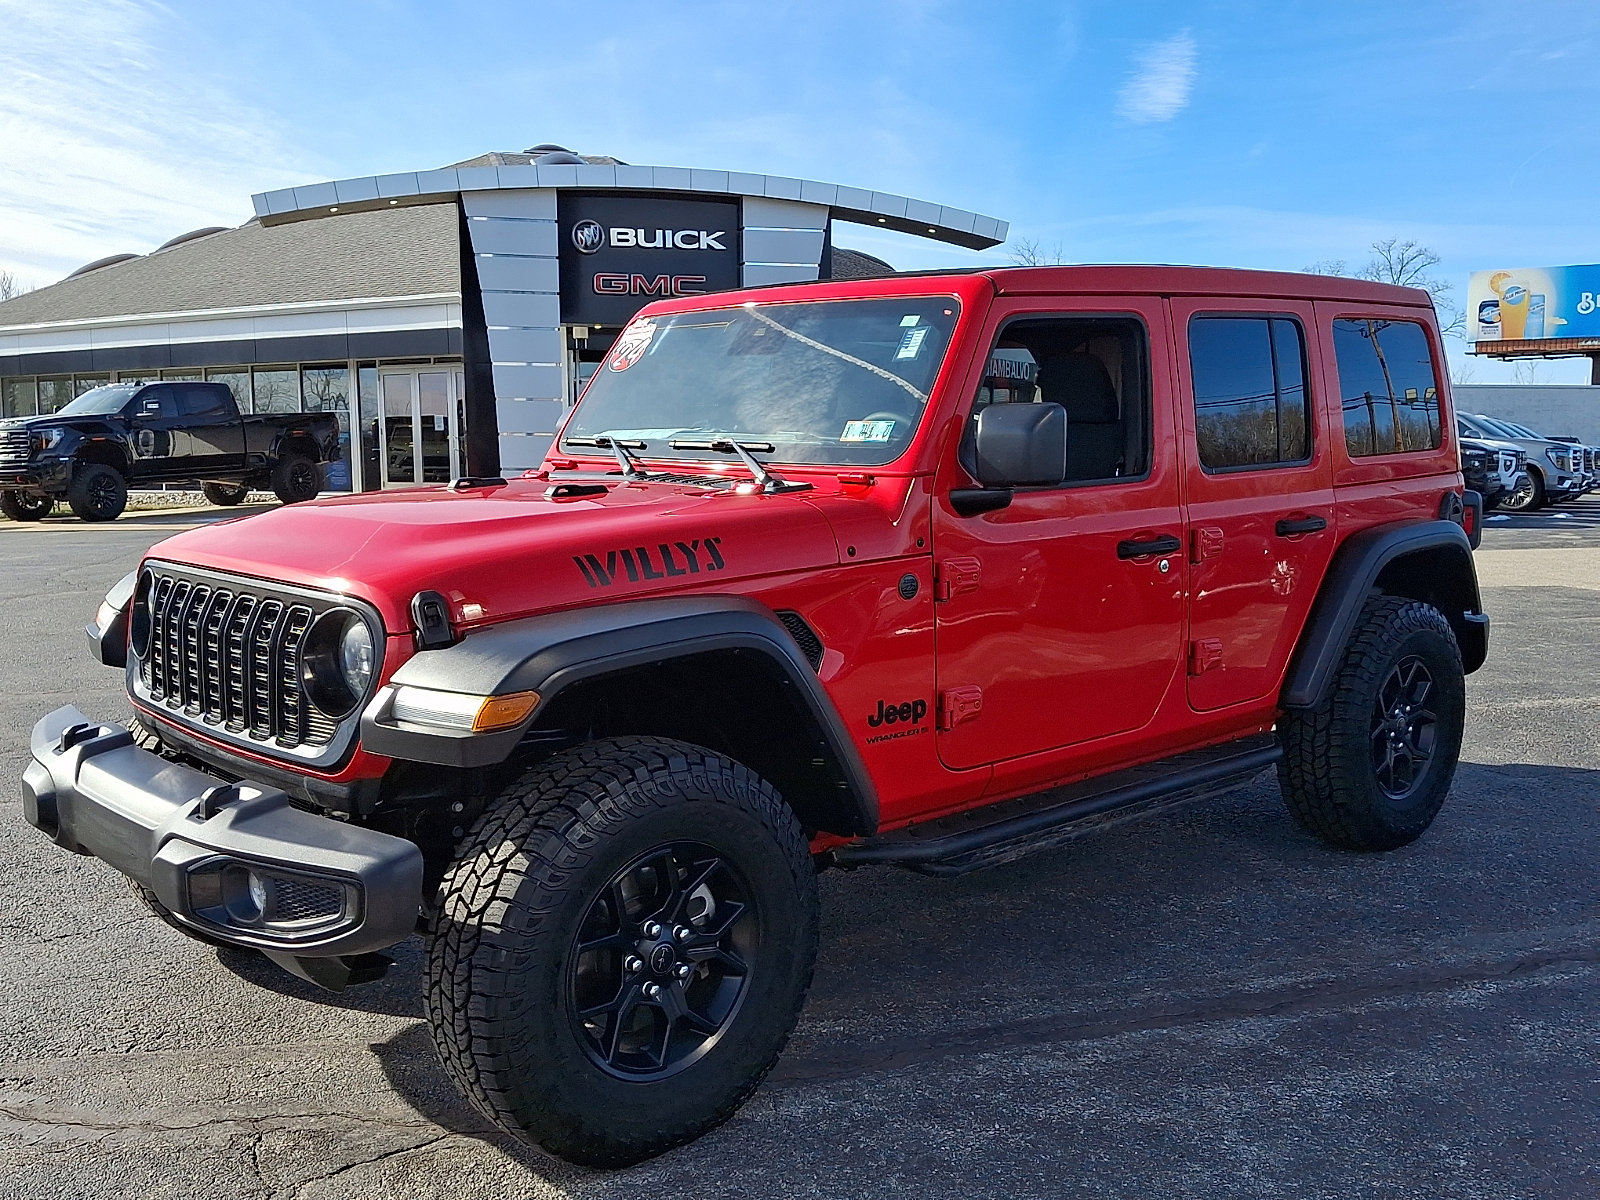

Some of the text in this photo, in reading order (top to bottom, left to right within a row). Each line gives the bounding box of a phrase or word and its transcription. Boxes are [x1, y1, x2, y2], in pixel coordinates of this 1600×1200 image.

[609, 227, 727, 250] BUICK
[593, 272, 707, 296] GMC
[571, 536, 725, 588] WILLYS
[867, 698, 927, 728] Jeep
[865, 728, 919, 744] WRANGLER
